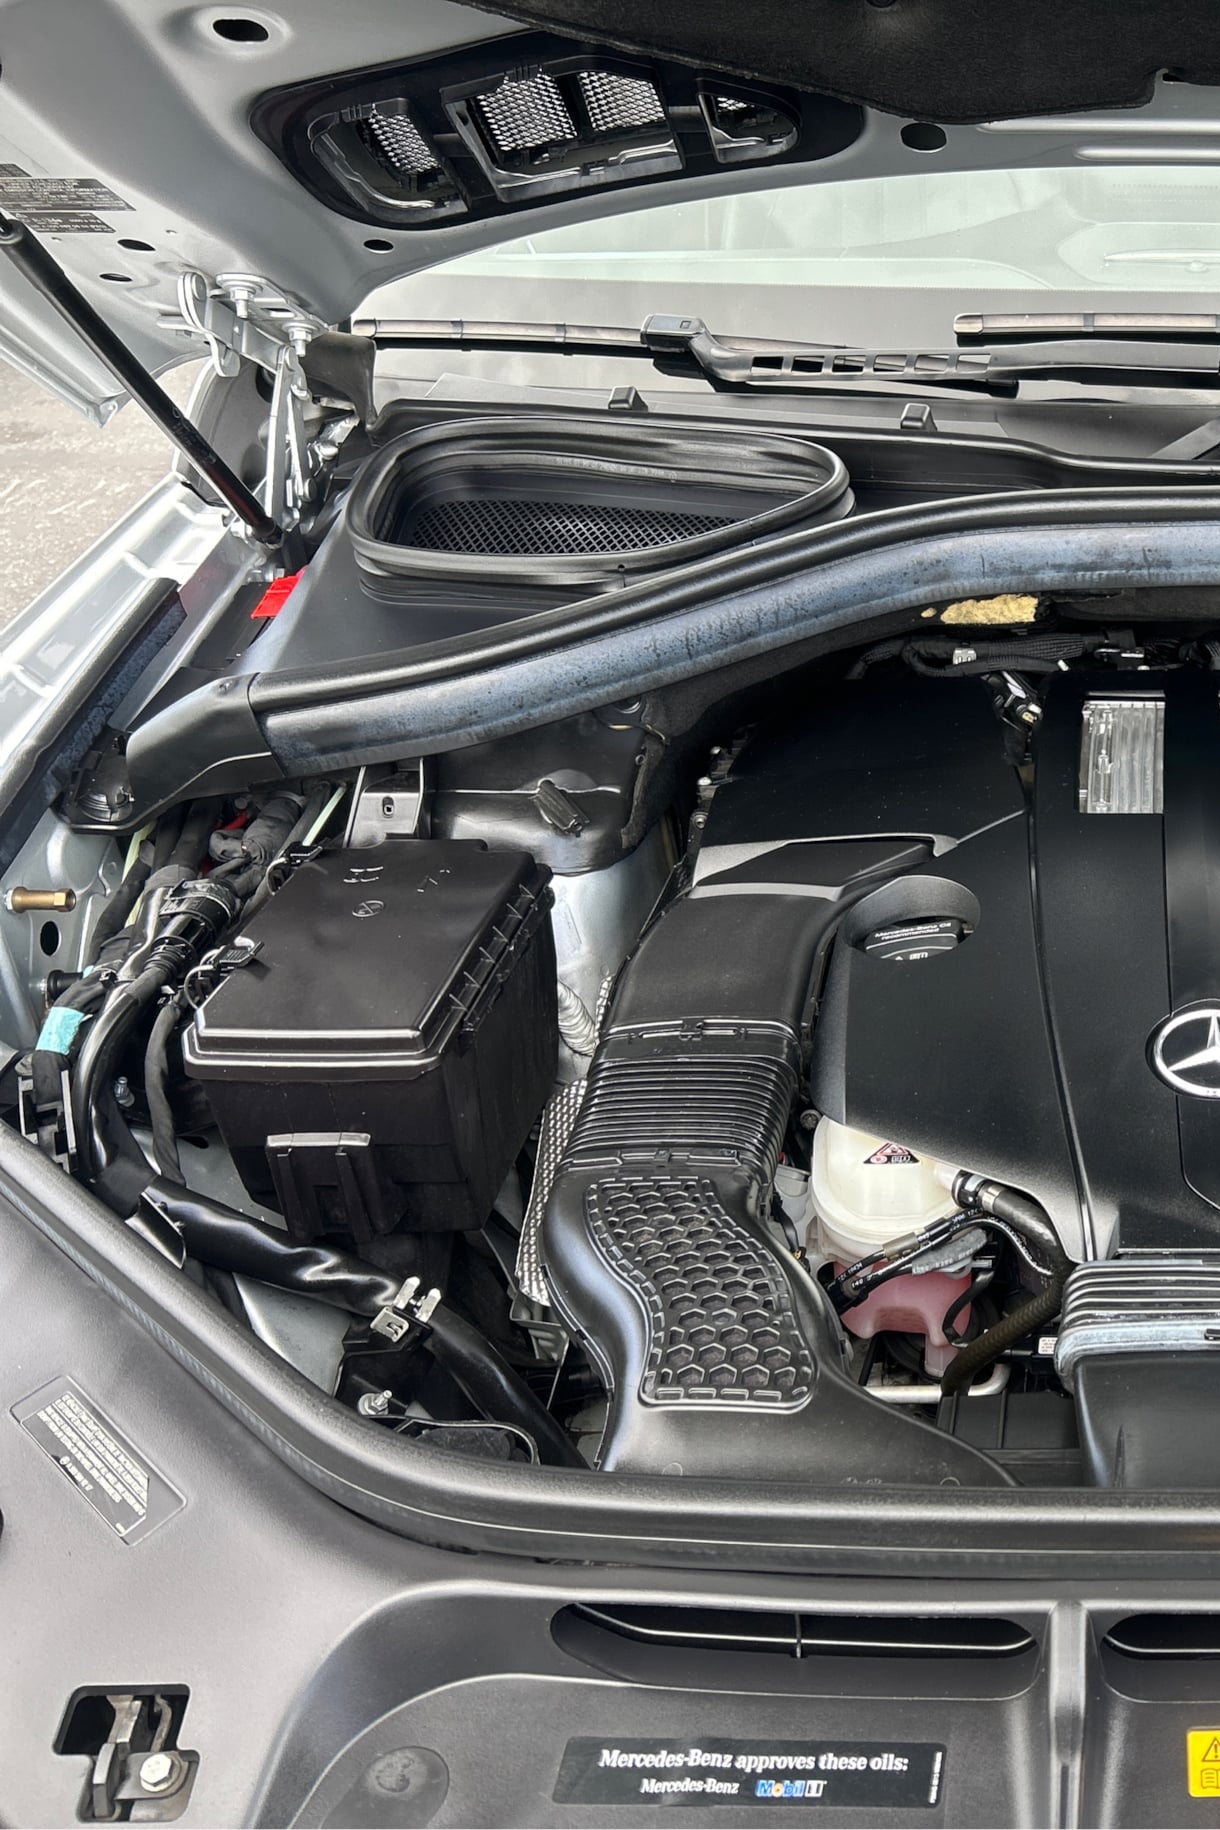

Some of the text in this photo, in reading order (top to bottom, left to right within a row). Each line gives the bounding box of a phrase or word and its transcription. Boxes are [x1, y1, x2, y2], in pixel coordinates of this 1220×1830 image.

[875, 924, 938, 938] Mercedes-Benz
[881, 928, 940, 941] recommended
[598, 1748, 910, 1773] Mercedes-Benz approves these oils:
[639, 1776, 741, 1794] Mercedes-Benz
[755, 1779, 806, 1798] Mobil
